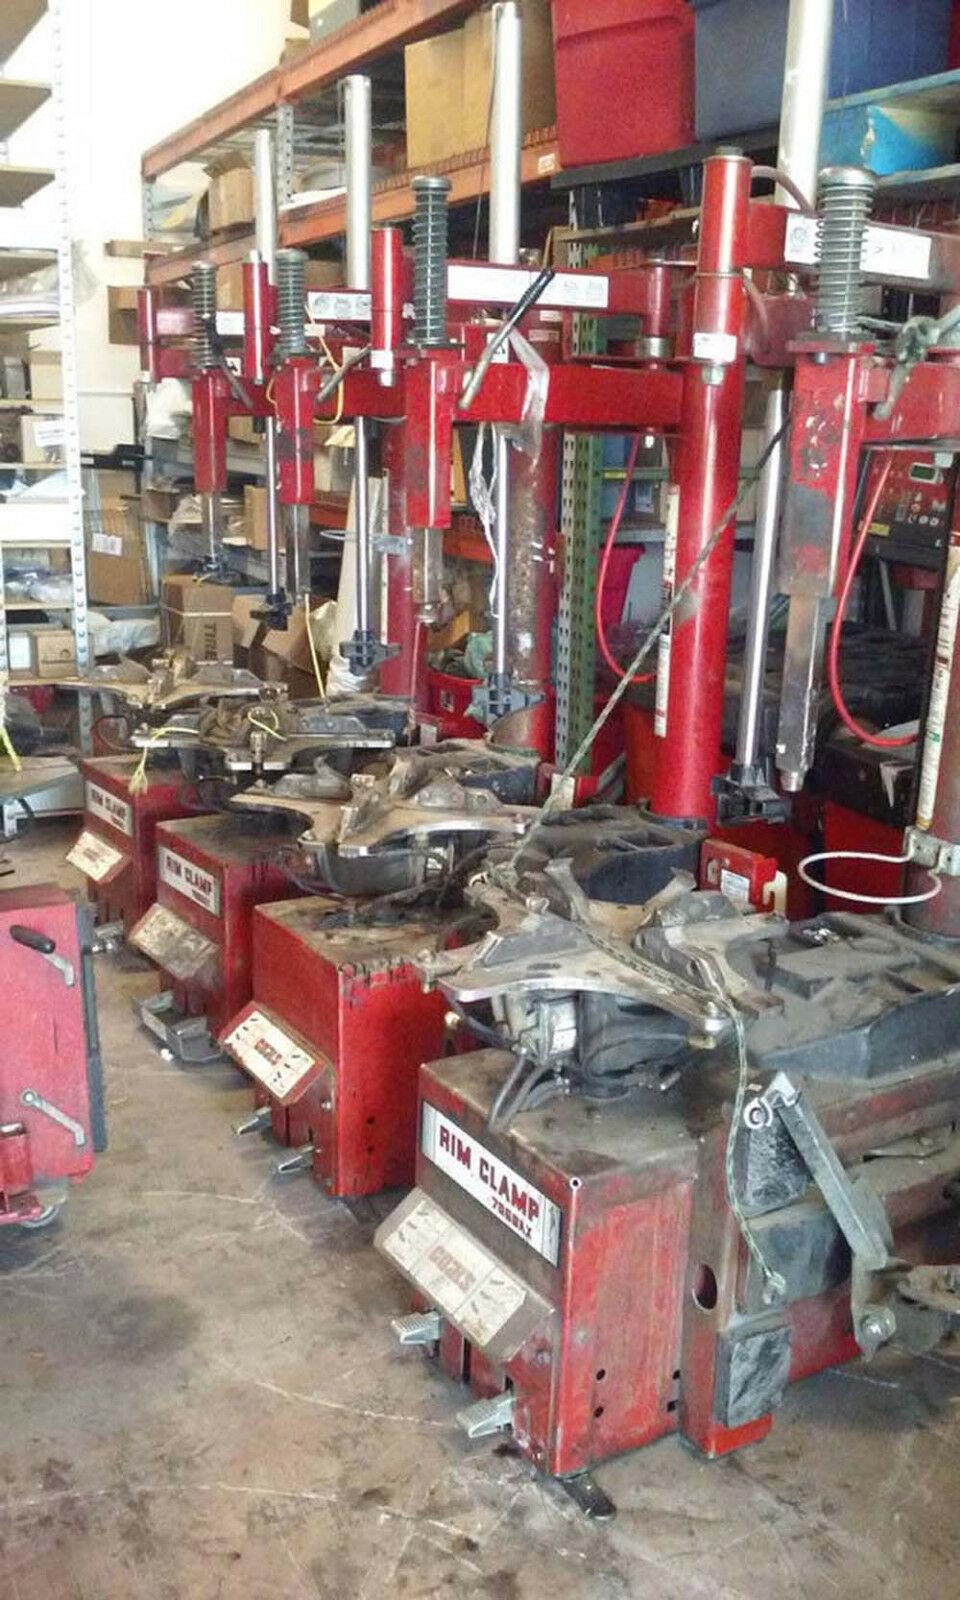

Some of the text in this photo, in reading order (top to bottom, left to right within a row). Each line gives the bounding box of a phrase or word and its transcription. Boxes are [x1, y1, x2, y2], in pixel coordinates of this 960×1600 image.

[166, 855, 212, 896] RIM CLAMP
[439, 1124, 540, 1222] RIM CLAMP
